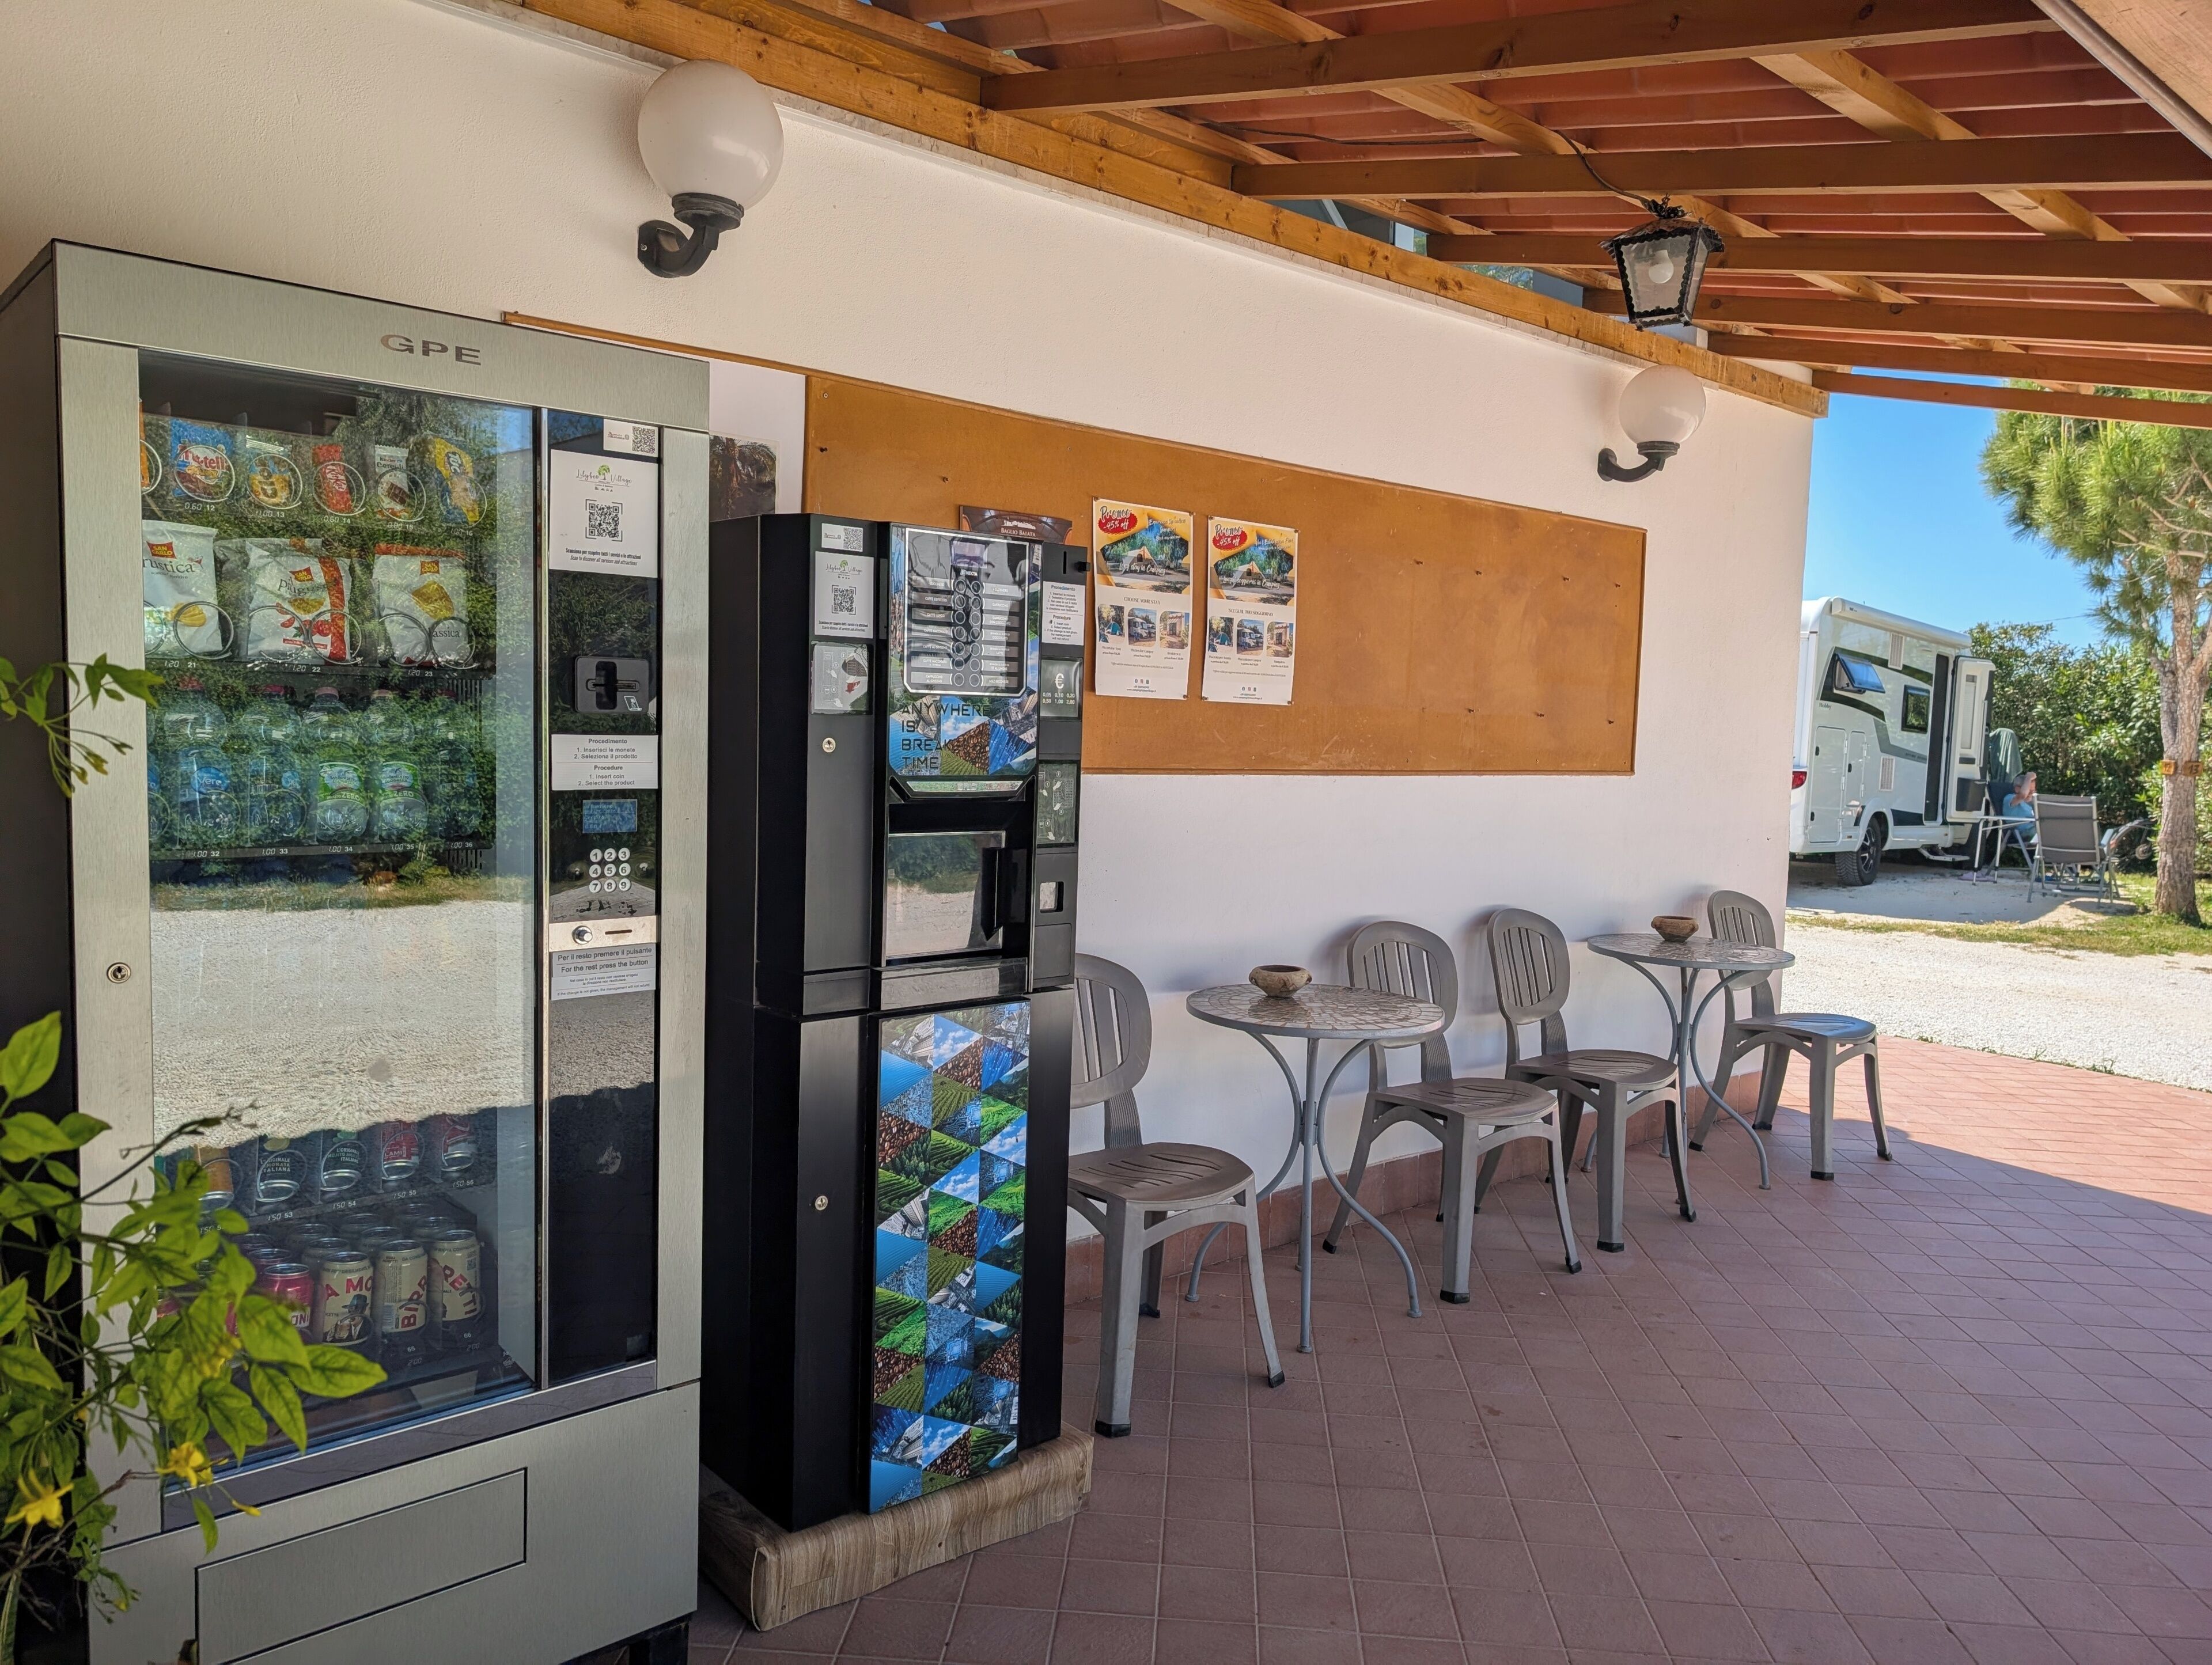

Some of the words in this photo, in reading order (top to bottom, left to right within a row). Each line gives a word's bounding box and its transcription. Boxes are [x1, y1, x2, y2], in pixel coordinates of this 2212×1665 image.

[381, 334, 481, 366] GPE
[611, 474, 632, 486] Village
[1100, 506, 1132, 522] Promo
[1120, 519, 1129, 530] off
[1001, 527, 1018, 535] BAGLIO
[1019, 529, 1036, 537] BAIATA
[1214, 524, 1244, 540] Promo
[1232, 536, 1240, 546] off
[142, 558, 195, 573] rustica
[1130, 563, 1141, 572] stay
[1146, 564, 1165, 576] Camping
[1262, 578, 1280, 589] Camping
[432, 627, 461, 638] assica
[1055, 673, 1065, 689] €
[902, 702, 991, 716] ANYWHERE
[902, 720, 916, 733] IS
[902, 738, 953, 752] BREAK
[902, 757, 939, 769] TIME
[341, 792, 360, 801] ZERO
[593, 951, 620, 959] premere
[626, 947, 652, 957] pulsante
[599, 962, 617, 970] press
